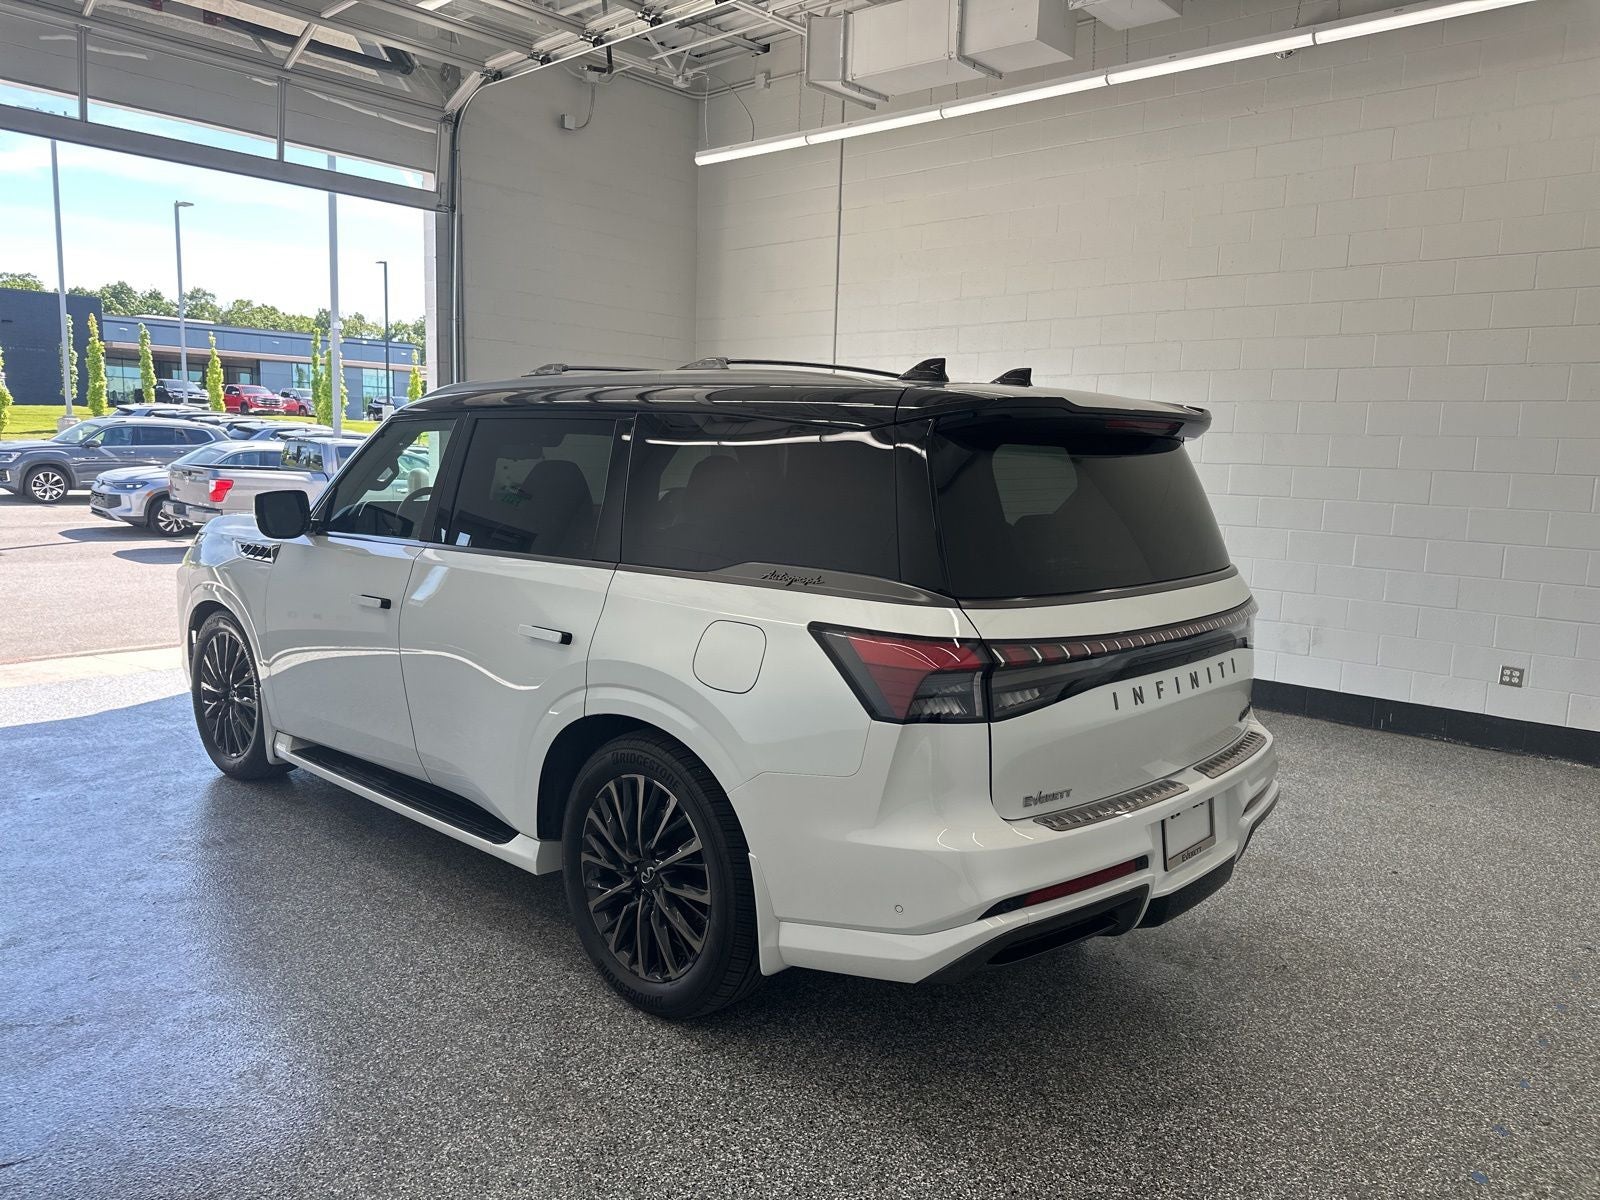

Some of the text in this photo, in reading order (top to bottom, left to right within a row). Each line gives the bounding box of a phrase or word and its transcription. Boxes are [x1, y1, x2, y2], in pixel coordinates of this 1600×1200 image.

[760, 569, 825, 586] Autograph
[1112, 657, 1237, 710] INFINITI
[611, 752, 680, 790] BRIDGESTONE
